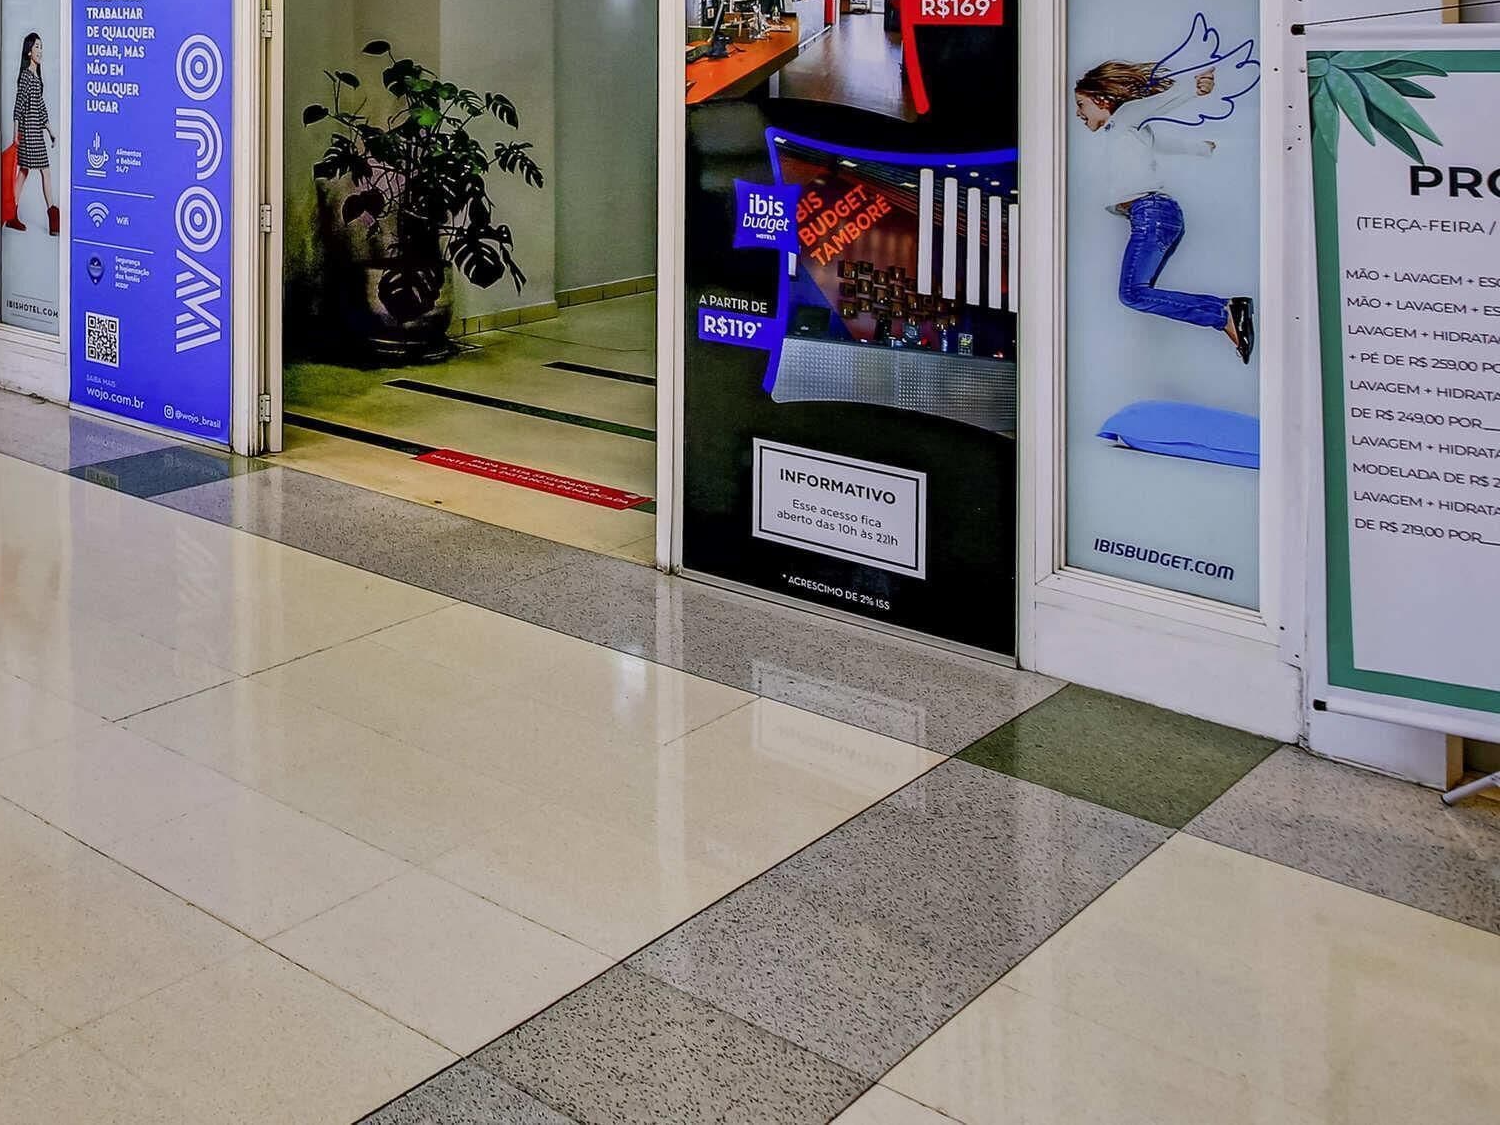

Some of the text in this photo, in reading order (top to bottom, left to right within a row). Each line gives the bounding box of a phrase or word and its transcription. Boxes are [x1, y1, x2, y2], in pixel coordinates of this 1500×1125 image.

[86, 7, 144, 20] TRABALHAR
[86, 25, 156, 43] DE QUALQUER
[86, 44, 145, 60] LUGAR, MAS
[86, 59, 124, 76] NÃO EM
[86, 81, 140, 99] QUALQUER
[86, 99, 119, 114] LUGAR
[749, 193, 785, 217] ibis
[742, 213, 790, 234] budget
[798, 184, 867, 247] BUDGET
[1356, 215, 1486, 235] (TERÇA-FEIRA
[810, 194, 892, 266] TAMBORÉ
[1345, 267, 1463, 286] MÃO LAVAGEM
[699, 293, 768, 315] A PARTIR DE
[1346, 295, 1468, 315] MÃO LAVAGEM
[1347, 324, 1418, 339] LAVAGEM
[1360, 351, 1478, 373] PÉ DE R$ 259,00
[86, 385, 145, 410] wojo.com.br
[1349, 379, 1421, 396] LAVAGEM
[174, 409, 221, 429] @wojo_brasil
[1350, 407, 1372, 420] DE
[1375, 409, 1395, 421] R$
[1396, 410, 1445, 426] 249,00
[1351, 434, 1423, 452] LAVAGEM
[1352, 462, 1490, 488] MODELADA DE R$
[779, 467, 897, 505] INFORMATIVO
[1353, 489, 1423, 508] LAVAGEM
[792, 499, 882, 528] Esse acesso fica
[776, 509, 814, 526] aberto
[815, 516, 836, 532] das
[838, 522, 858, 537] 10h
[860, 528, 874, 540] às
[1354, 517, 1377, 530] DE
[1379, 520, 1399, 533] R$
[1401, 523, 1445, 540] 219,00
[1093, 537, 1236, 581] IBISBUDGET.COM
[844, 589, 859, 602] DE
[859, 593, 875, 606] 2%
[875, 597, 891, 611] ISS
